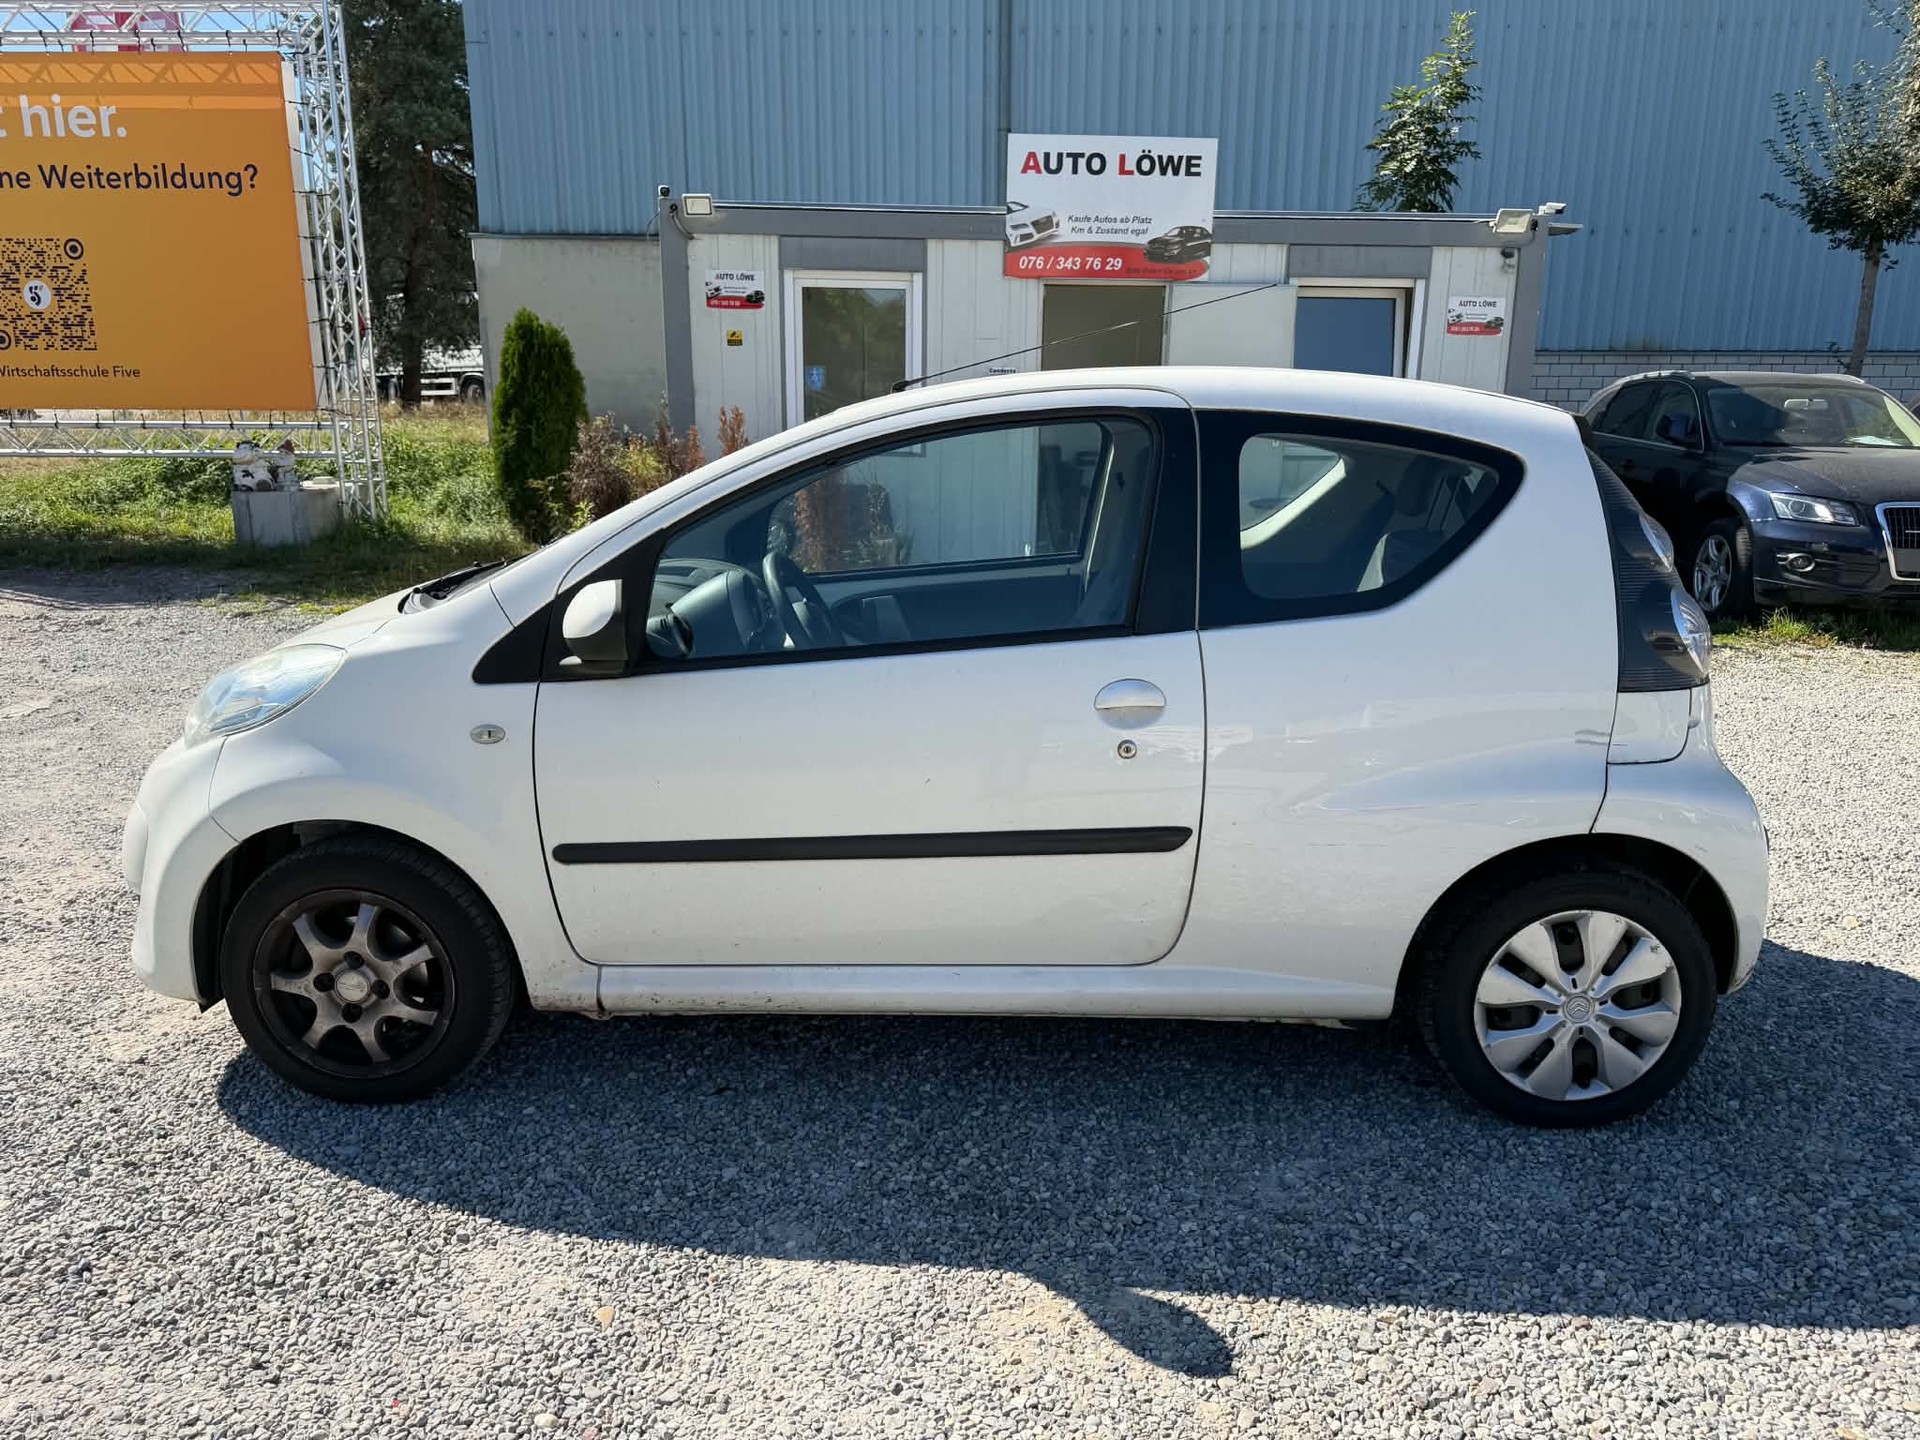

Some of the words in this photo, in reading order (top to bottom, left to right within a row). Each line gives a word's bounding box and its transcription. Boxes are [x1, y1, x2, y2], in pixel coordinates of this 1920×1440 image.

[18, 93, 128, 138] hier.
[1020, 151, 1107, 176] AUTO
[1118, 149, 1203, 177] LÖWE
[37, 162, 259, 197] Weiterbildung?
[1067, 214, 1092, 223] Kaufe
[1093, 215, 1118, 224] Autos
[1119, 216, 1130, 224] ab
[1131, 215, 1153, 224] Platz
[1095, 226, 1129, 235] Zustand
[1130, 226, 1149, 236] egal
[1018, 256, 1044, 270] 076
[1046, 256, 1053, 270] /
[1056, 256, 1081, 270] 343
[1085, 257, 1101, 271] 76
[1105, 257, 1123, 271] 29
[1458, 300, 1478, 308] AUTO
[112, 365, 141, 378] Five
